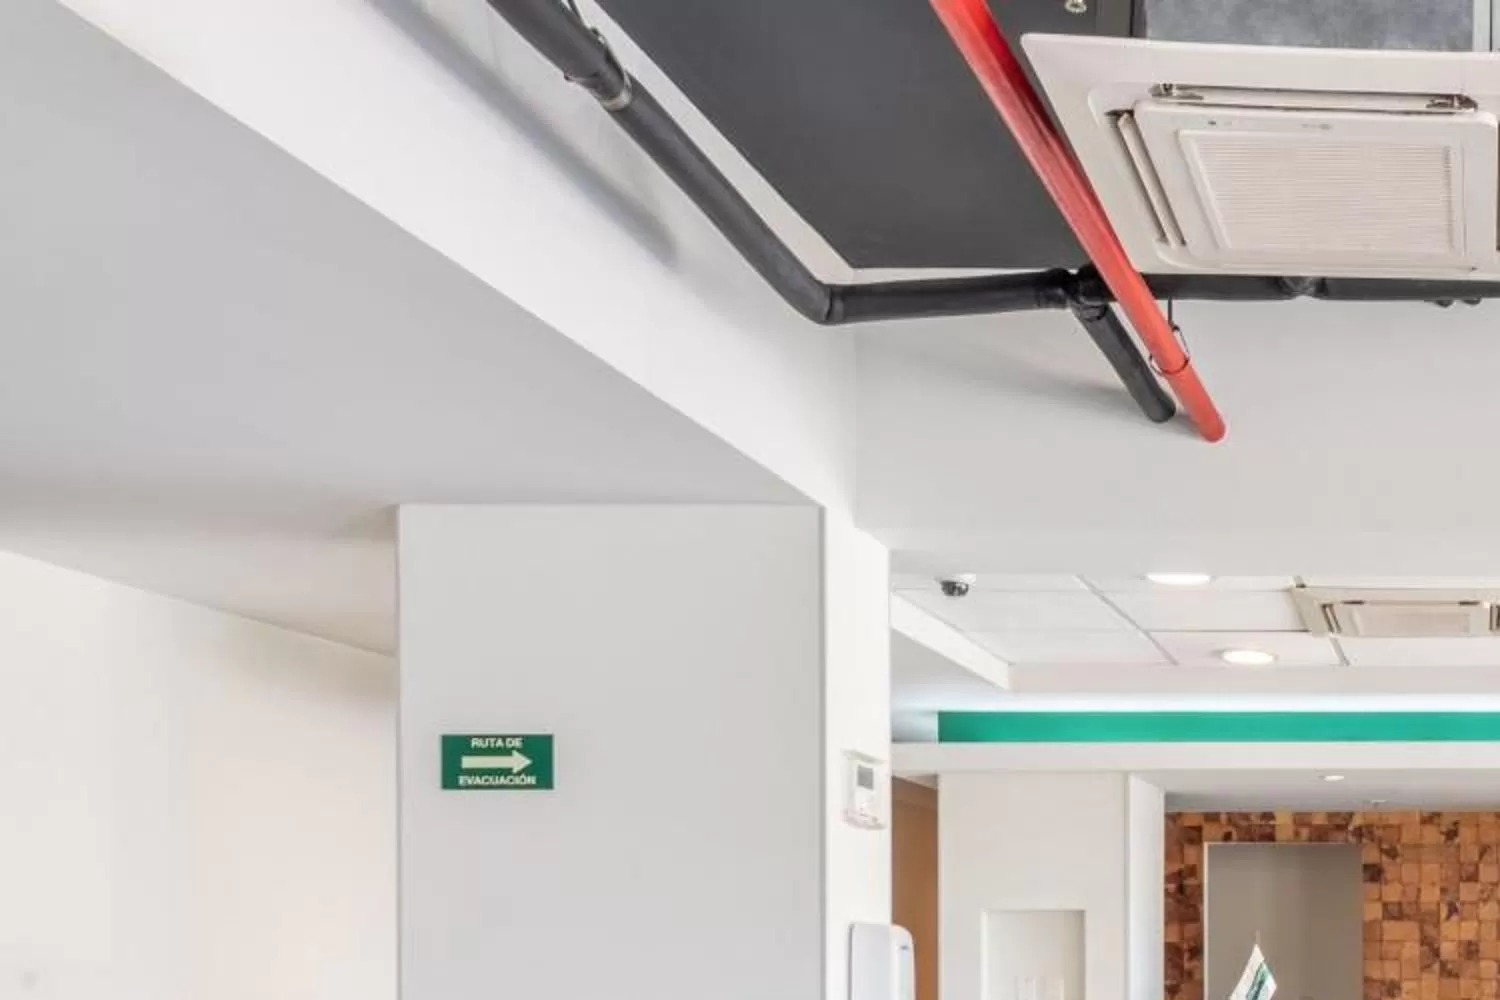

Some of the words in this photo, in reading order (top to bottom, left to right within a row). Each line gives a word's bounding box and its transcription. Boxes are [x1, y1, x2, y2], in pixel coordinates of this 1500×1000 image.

[471, 737, 504, 748] RUTA
[506, 737, 523, 748] DE
[458, 773, 537, 785] EVACUACIÓN
